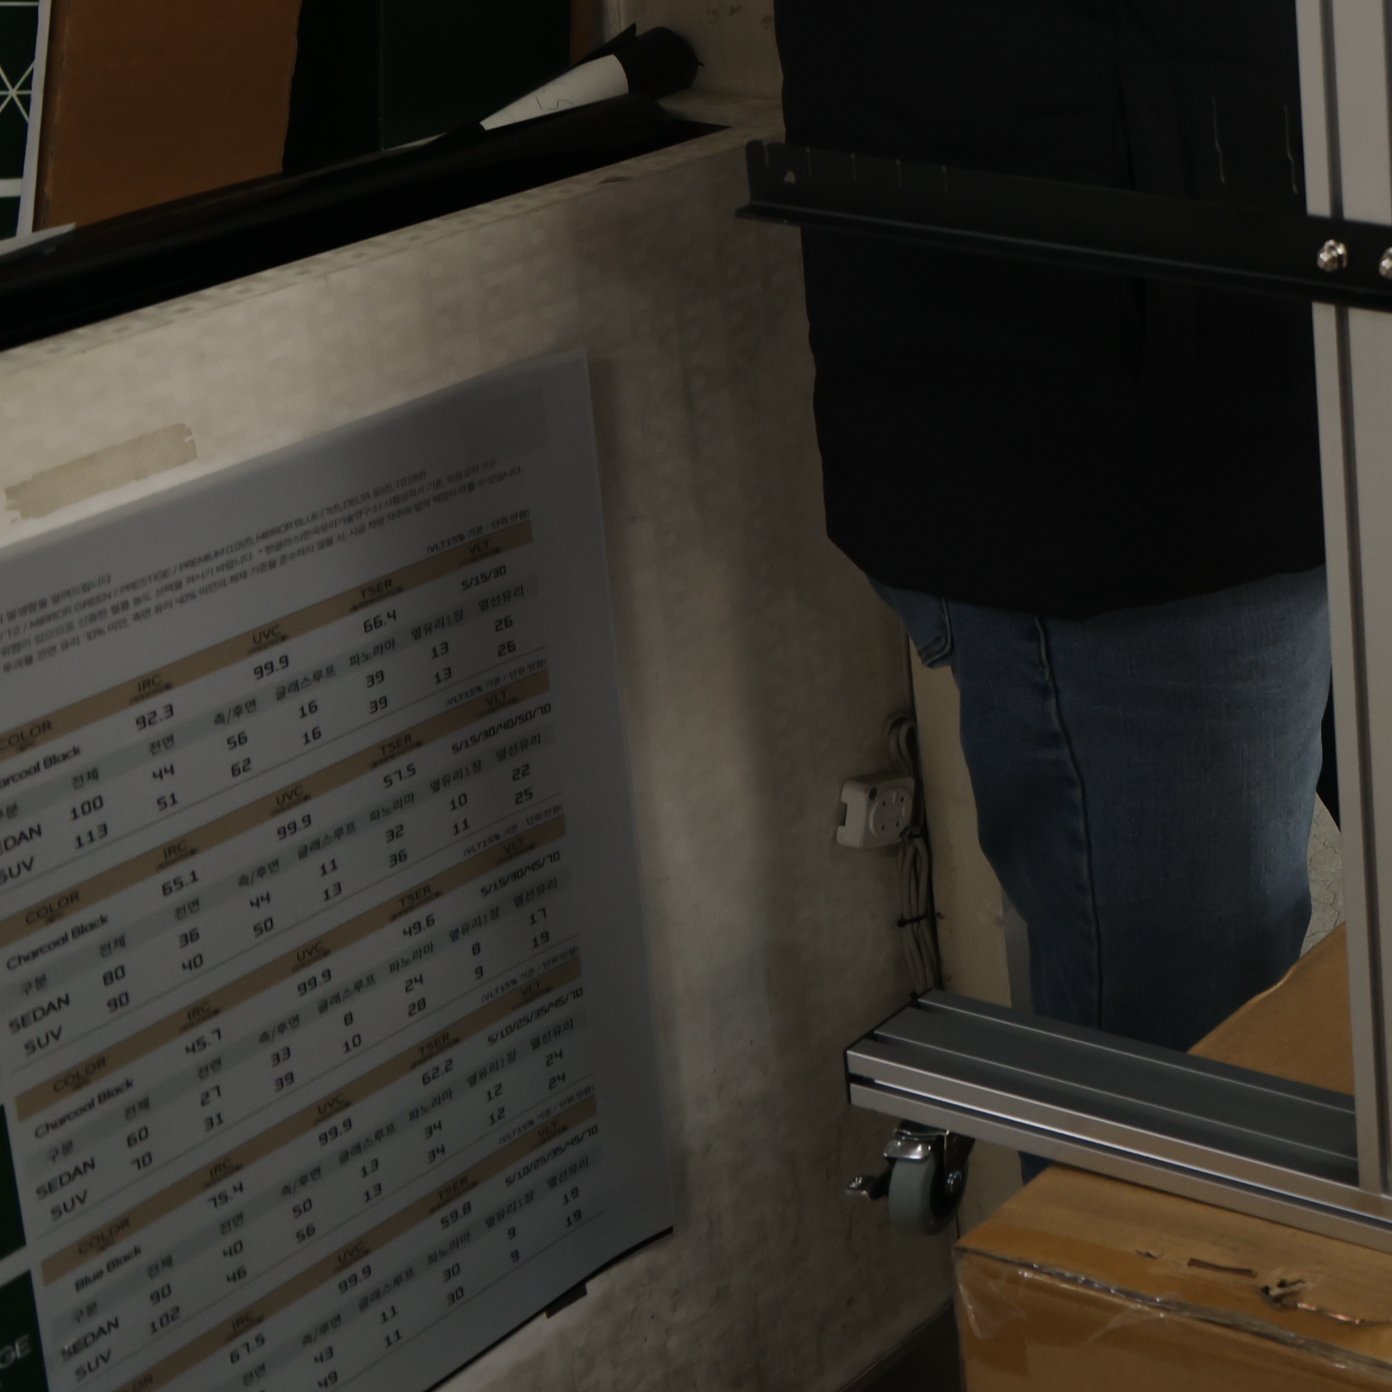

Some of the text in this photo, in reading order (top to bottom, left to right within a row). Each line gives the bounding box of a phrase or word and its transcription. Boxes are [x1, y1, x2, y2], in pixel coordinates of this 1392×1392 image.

[135, 564, 507, 732] 92.3 99.9 66.4 5/15/30
[69, 615, 514, 822] 100 44 56 16 39 13 26
[74, 640, 516, 850] 113 51 62 16 39 13 26
[5, 931, 69, 971] Charcoal
[70, 914, 110, 941] Black
[161, 870, 200, 898] 65.1
[383, 762, 417, 789] 57.5
[25, 891, 80, 926] COLOR
[8, 992, 70, 1036] SEDAN
[178, 927, 201, 949] 36
[23, 953, 204, 1058] SUV 90 40
[34, 1098, 95, 1139] Charcoal
[97, 1077, 135, 1105] Black
[185, 1027, 223, 1056] 45.7
[402, 913, 436, 938] 49.6
[35, 1157, 96, 1202] SEDAN
[51, 1188, 89, 1222] SUV
[75, 1268, 104, 1293] Blue
[106, 1244, 143, 1271] Black
[207, 1181, 244, 1210] 75.4
[421, 1058, 454, 1086] 62.2
[61, 1315, 120, 1364] SEDAN
[75, 1349, 112, 1384] SUV
